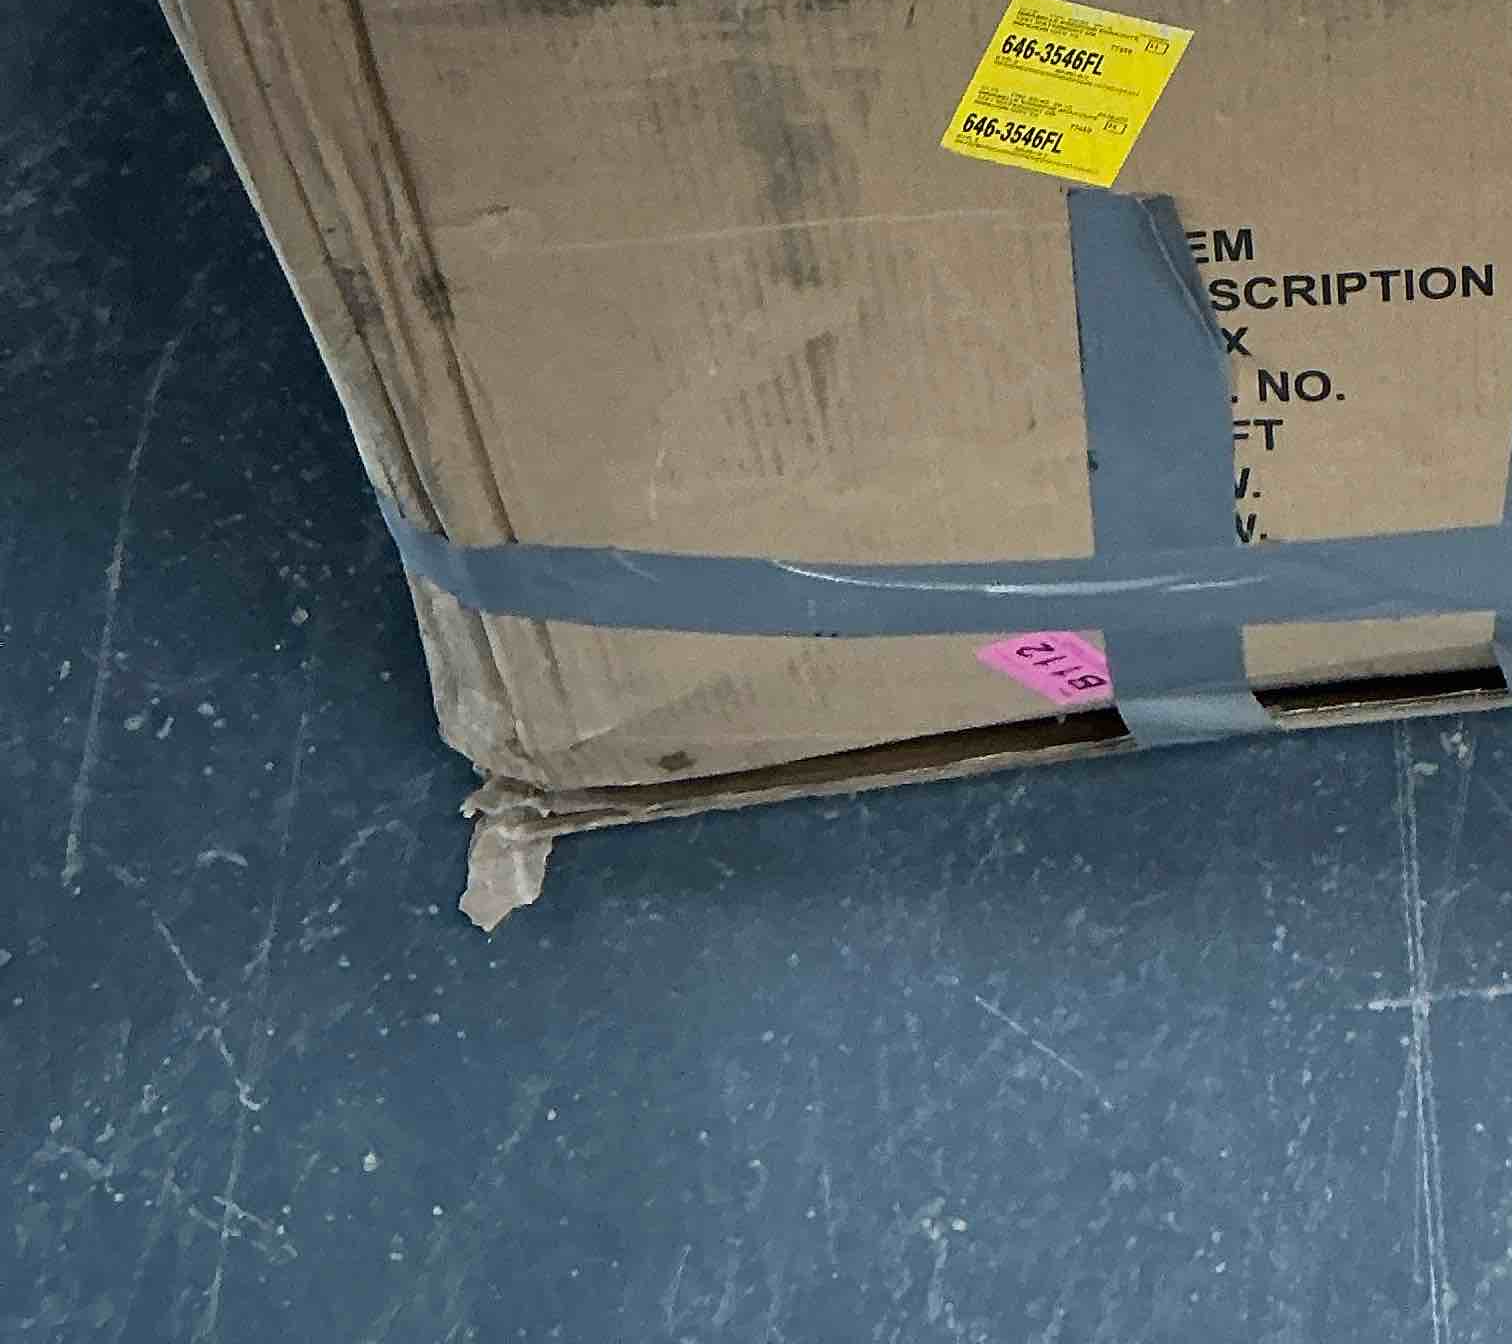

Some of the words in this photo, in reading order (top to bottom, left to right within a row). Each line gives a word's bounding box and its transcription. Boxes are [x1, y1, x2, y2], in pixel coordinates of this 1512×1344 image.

[1001, 34, 1105, 76] 646-3546FL
[962, 112, 1065, 154] 646-3546FL
[1185, 228, 1255, 264] EM
[1208, 262, 1495, 312] SCRIPTION
[1233, 418, 1284, 451] FT
